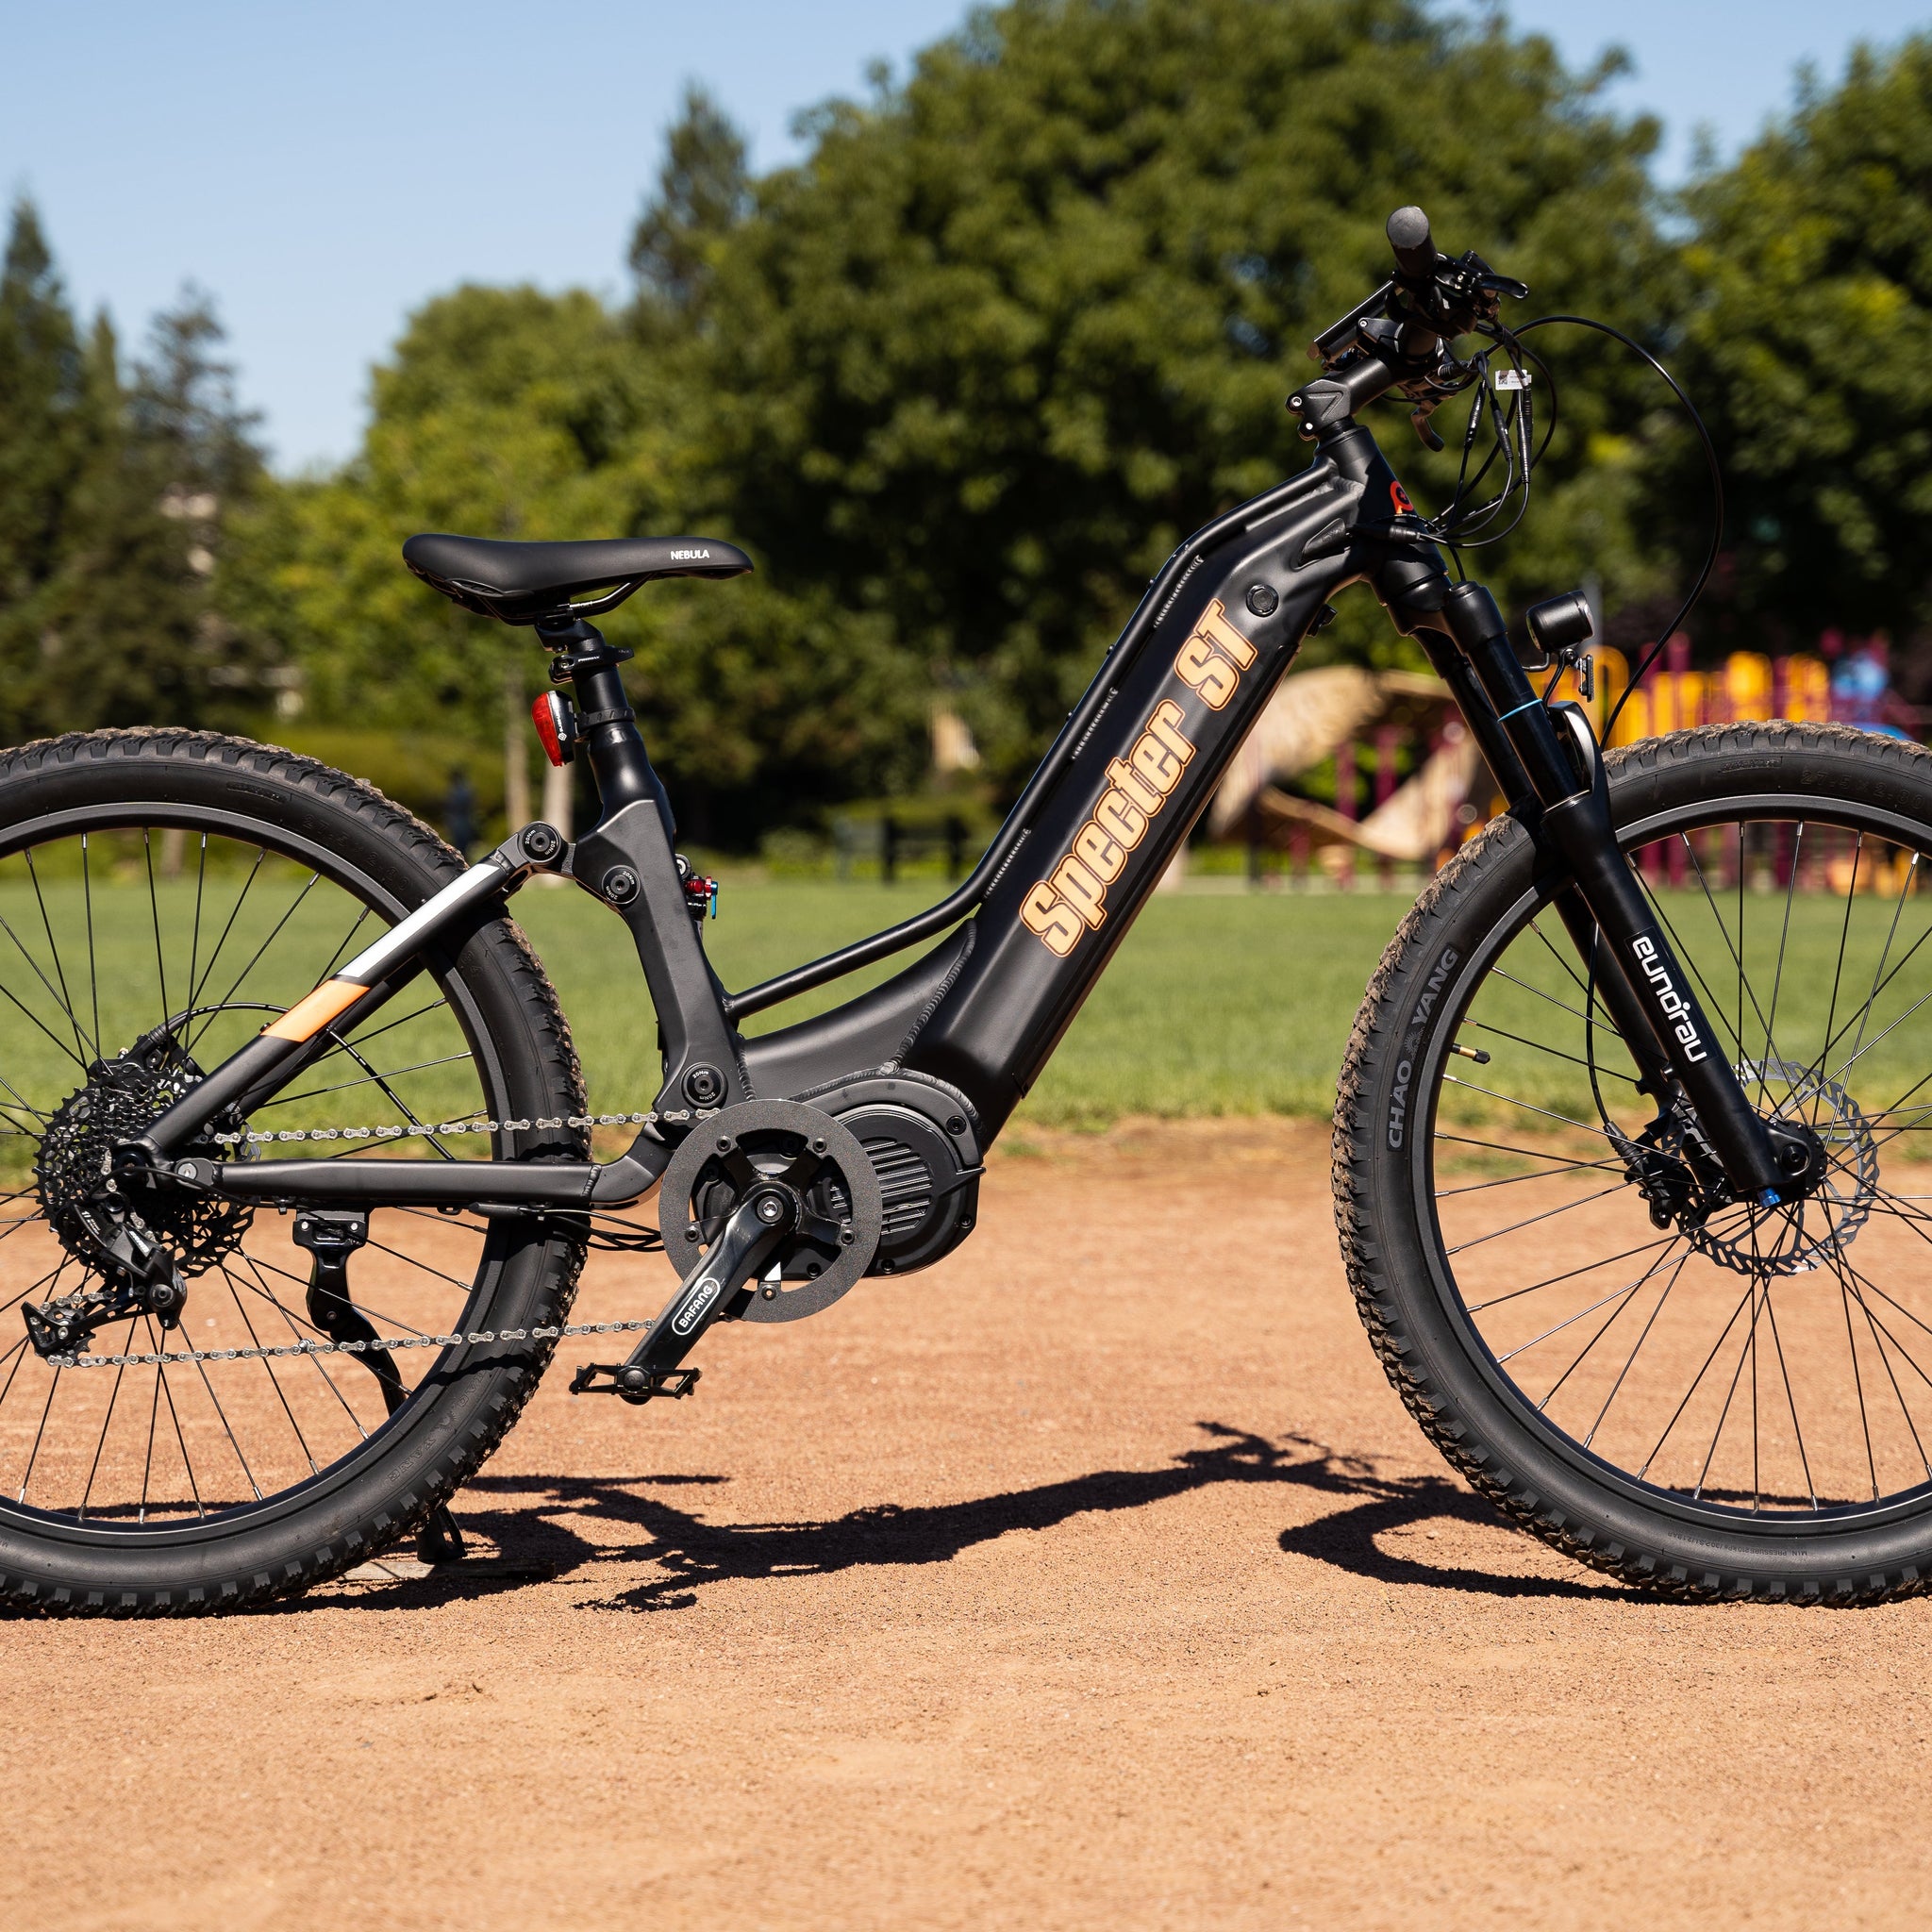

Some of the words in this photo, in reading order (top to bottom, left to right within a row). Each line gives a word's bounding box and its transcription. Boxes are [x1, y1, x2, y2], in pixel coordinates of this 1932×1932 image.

[670, 549, 710, 560] NEBULA
[1019, 698, 1198, 958] Specter
[1173, 597, 1258, 711] ST
[525, 829, 537, 845] 20Nm
[544, 840, 557, 856] 20Nm
[622, 870, 636, 885] 20Nm
[606, 885, 619, 901] 20Nm
[1632, 936, 1707, 1062] eunorau
[1389, 1059, 1413, 1149] CHAO
[1411, 948, 1458, 1025] YANG
[691, 1070, 709, 1079] 20Nm
[678, 1285, 713, 1328] BAFANG
